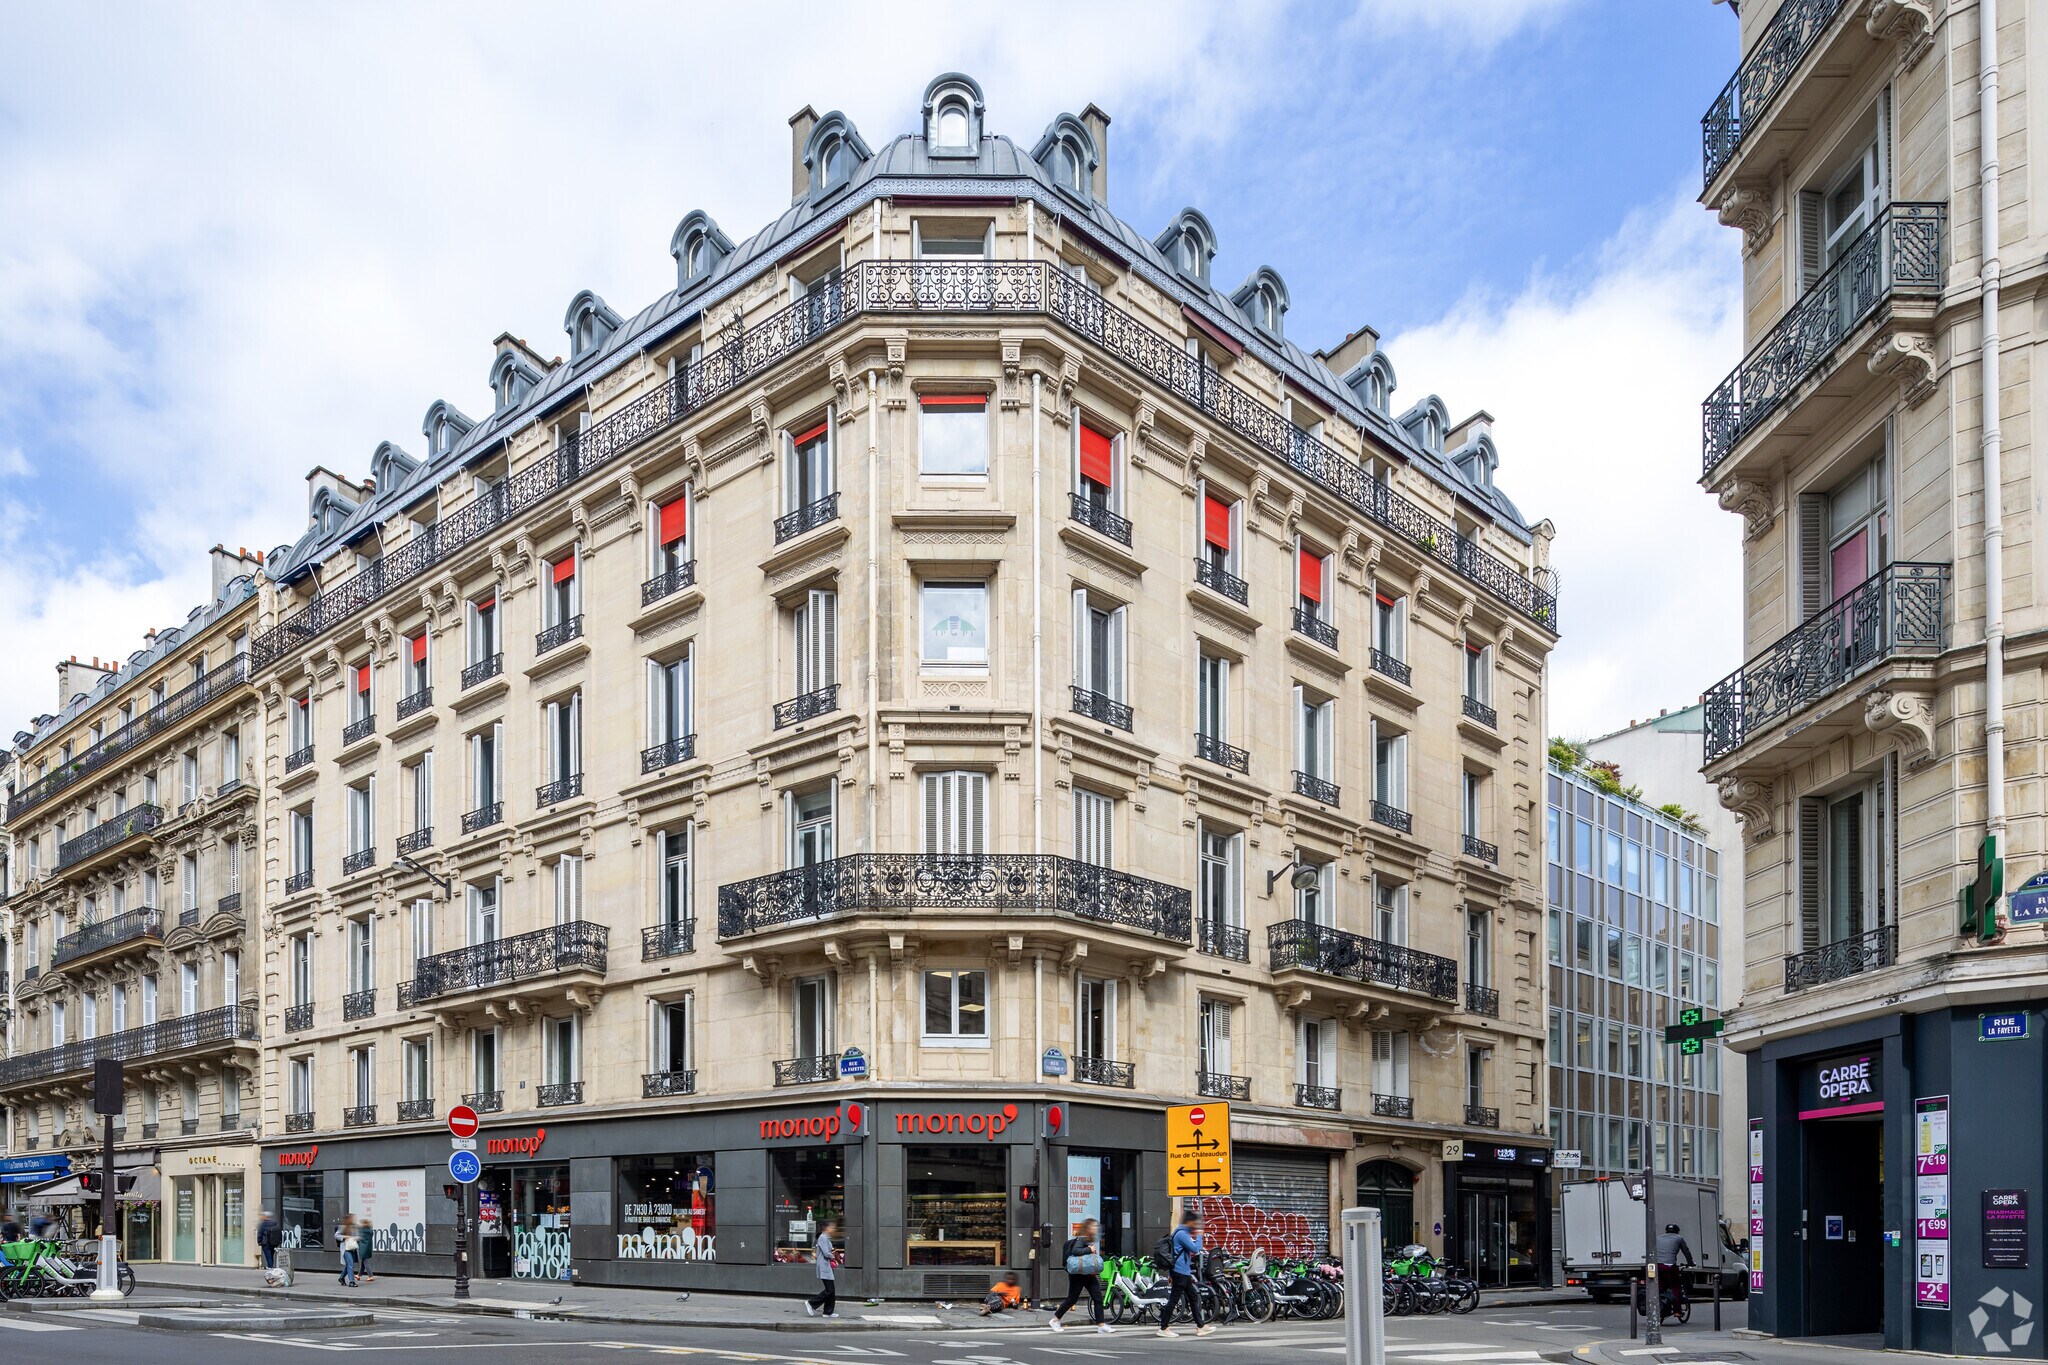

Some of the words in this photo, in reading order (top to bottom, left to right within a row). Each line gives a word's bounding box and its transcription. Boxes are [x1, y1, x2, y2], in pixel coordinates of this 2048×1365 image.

[2015, 909, 2030, 917] LA
[1994, 1018, 2015, 1026] RUE
[1998, 1026, 2020, 1034] FAYETTE
[1820, 1079, 1872, 1098] OPERA
[895, 1104, 1018, 1140] monop'
[487, 1128, 546, 1158] monop'
[1446, 1145, 1460, 1155] 29
[189, 1155, 217, 1164] OCTANE
[279, 1145, 318, 1168] monop'
[1918, 1154, 1947, 1173] 7€19
[624, 1204, 632, 1215] DE
[633, 1204, 648, 1215] 7H30
[648, 1201, 653, 1215] À
[1919, 1219, 1947, 1237] 1€99
